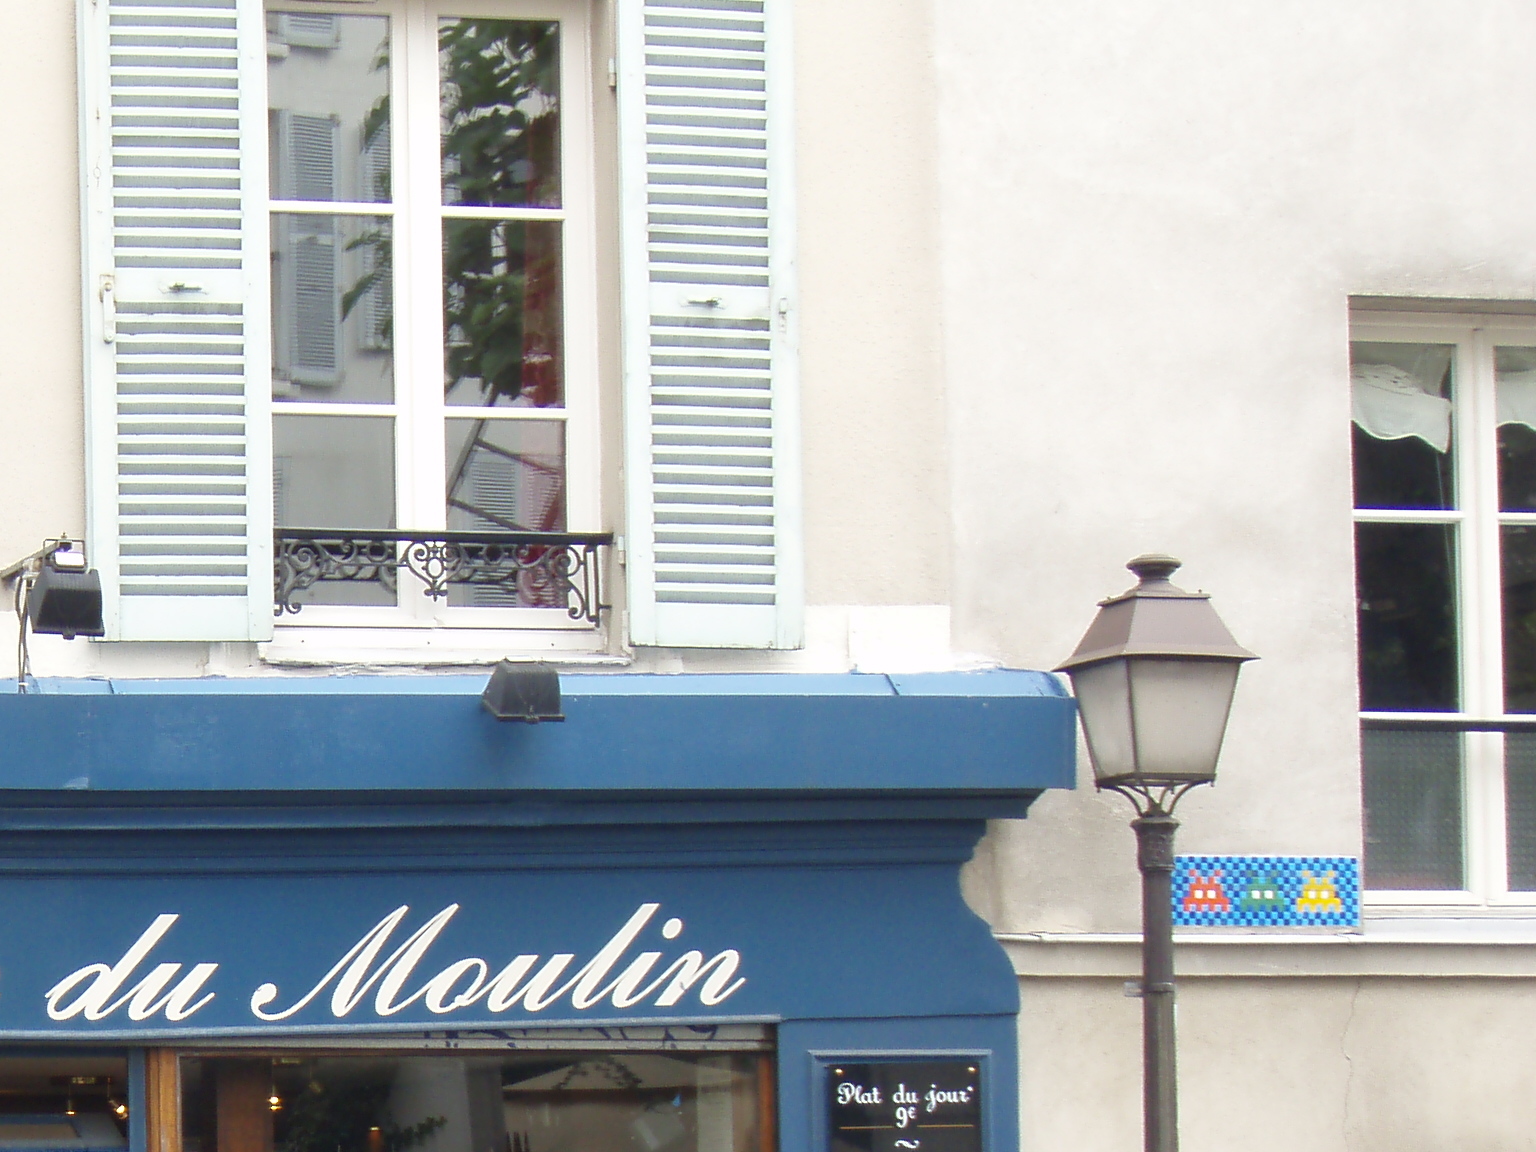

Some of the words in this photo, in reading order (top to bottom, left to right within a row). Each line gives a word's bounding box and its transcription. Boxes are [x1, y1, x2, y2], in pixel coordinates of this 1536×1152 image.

[45, 912, 218, 1021] du
[250, 902, 746, 1021] Moulin
[838, 1082, 882, 1104] Plat
[893, 1083, 919, 1104] du
[925, 1084, 974, 1112] jour
[896, 1106, 917, 1128] 9€
